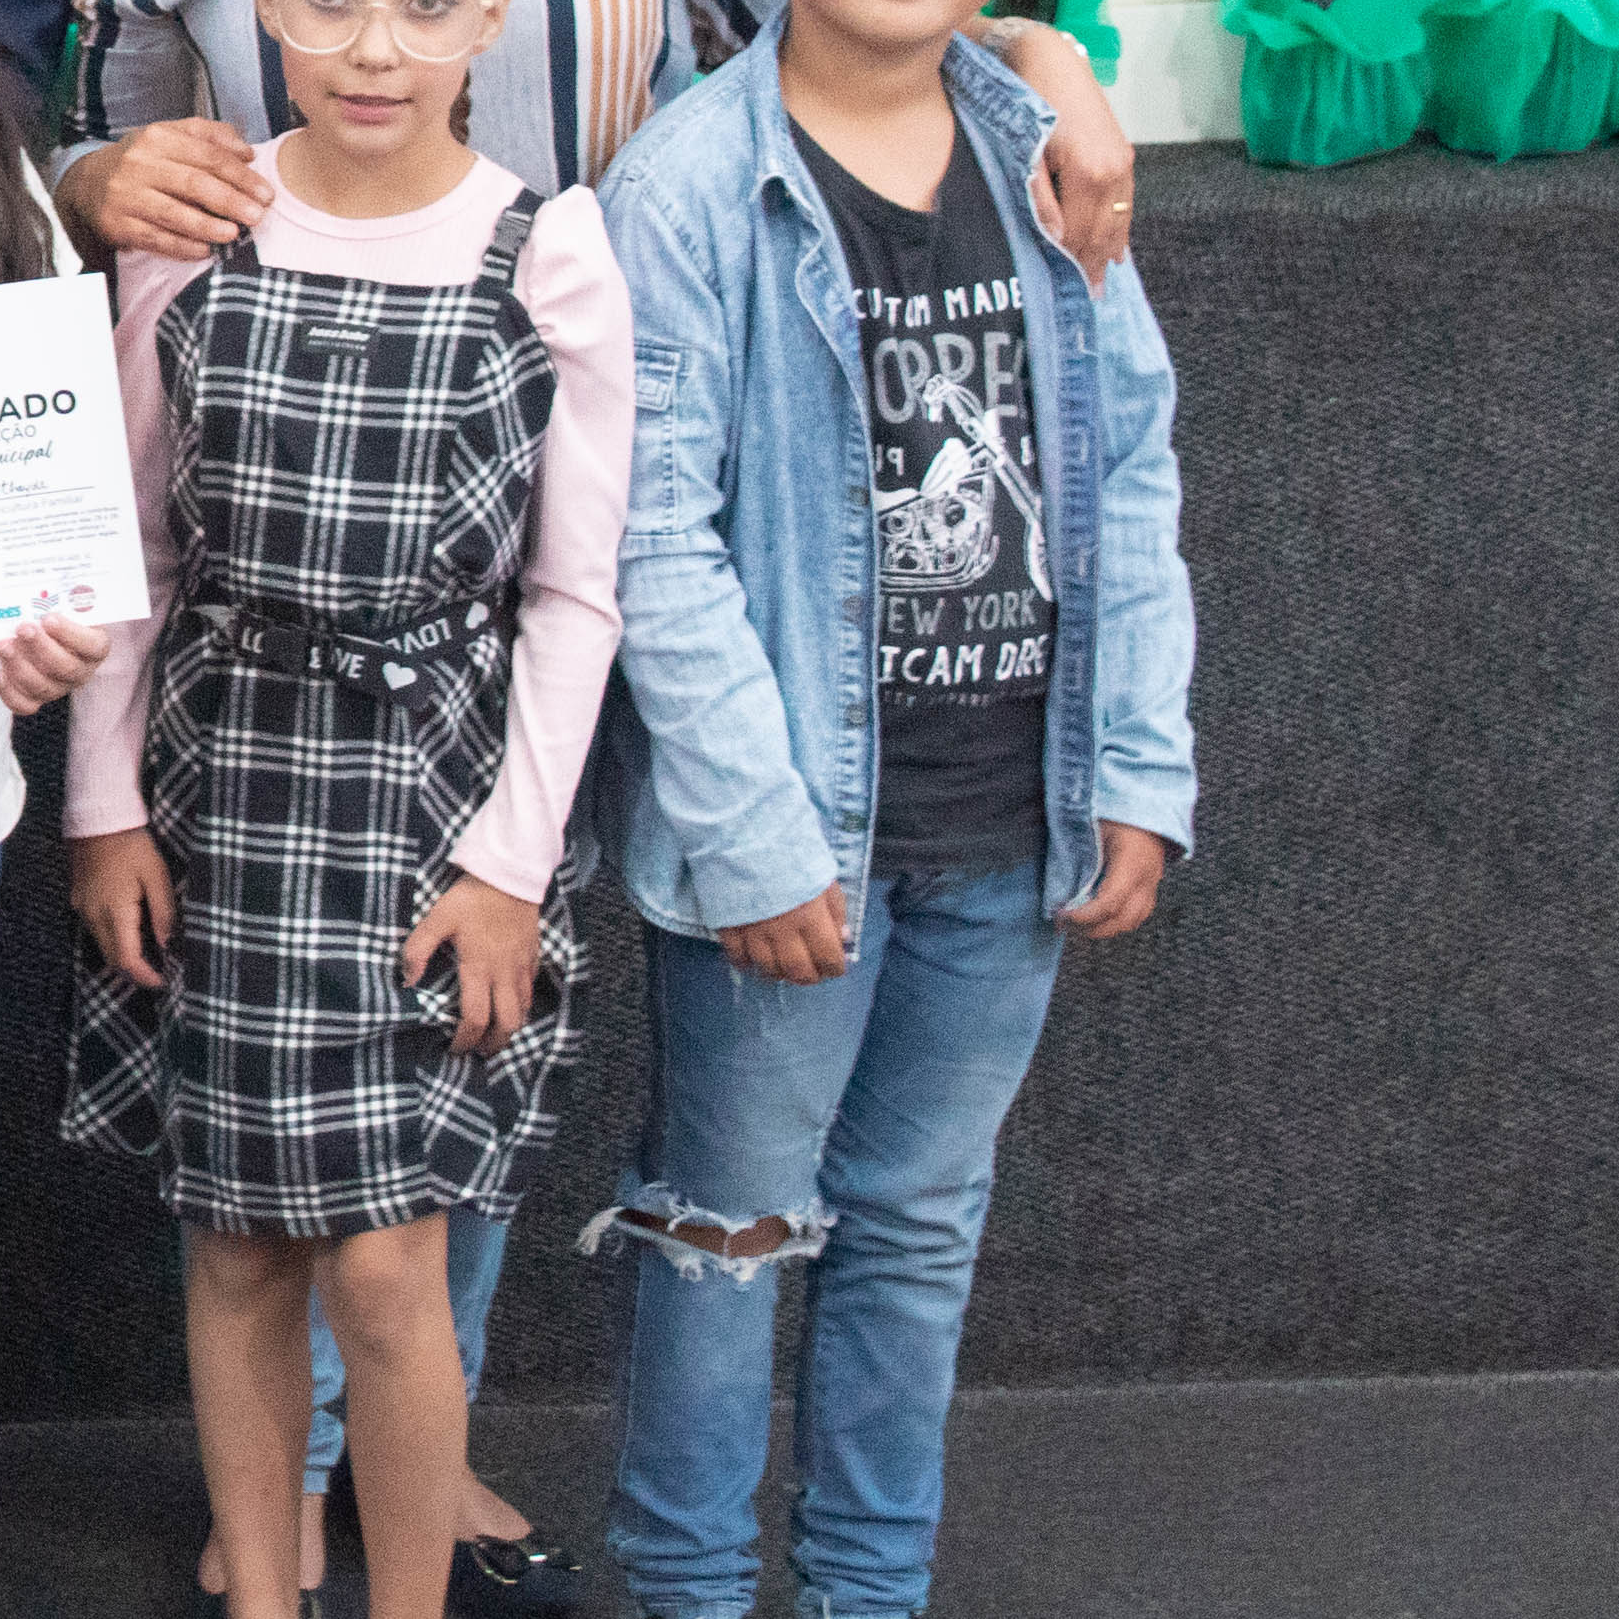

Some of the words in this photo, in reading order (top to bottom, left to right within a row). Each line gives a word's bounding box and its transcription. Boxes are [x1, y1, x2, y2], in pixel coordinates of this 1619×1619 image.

[944, 276, 1022, 321] MADE
[881, 595, 946, 635] EW
[963, 588, 1038, 631] YORK
